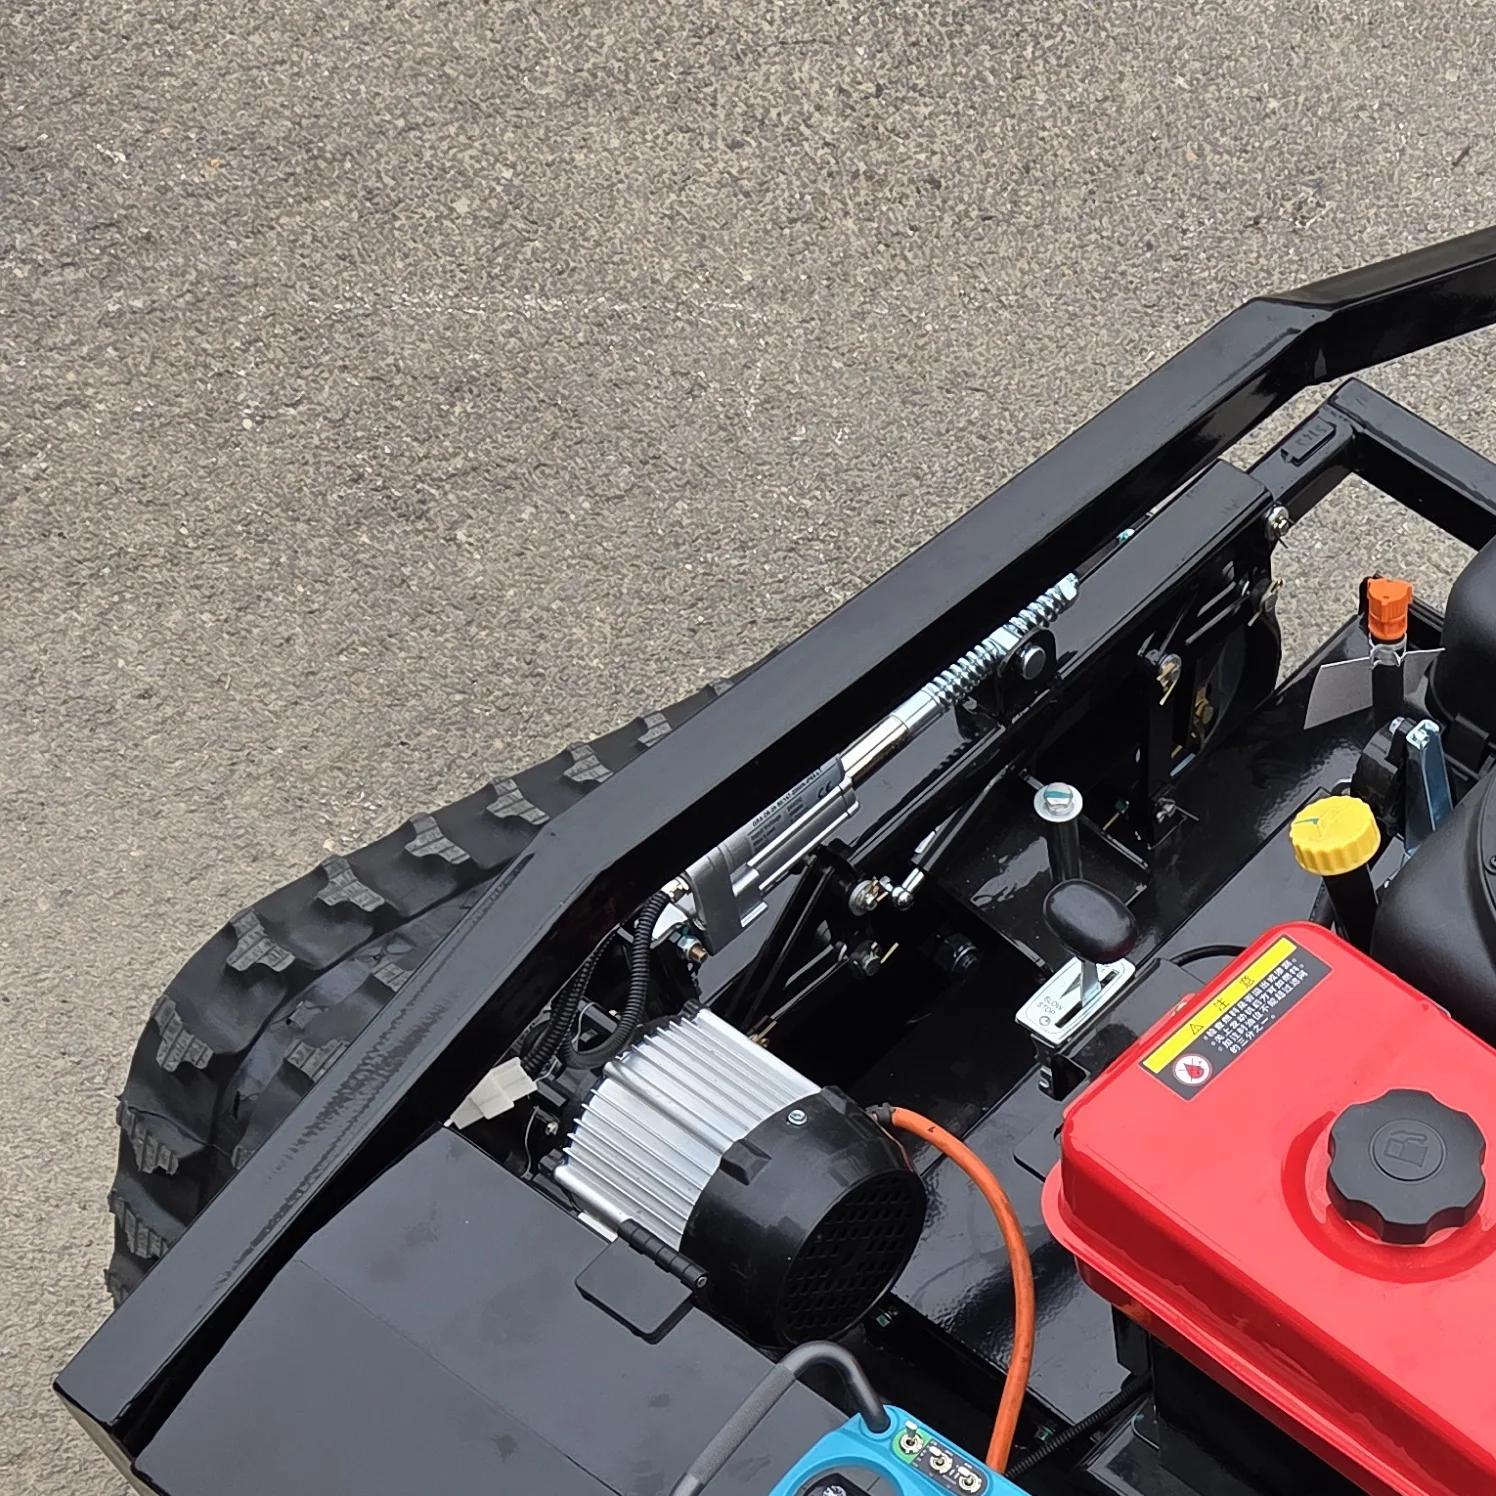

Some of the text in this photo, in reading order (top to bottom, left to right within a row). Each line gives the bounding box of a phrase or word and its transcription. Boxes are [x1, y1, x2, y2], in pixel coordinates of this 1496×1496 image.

[1211, 972, 1256, 1013] 注 意
[1035, 1000, 1056, 1016] STOP
